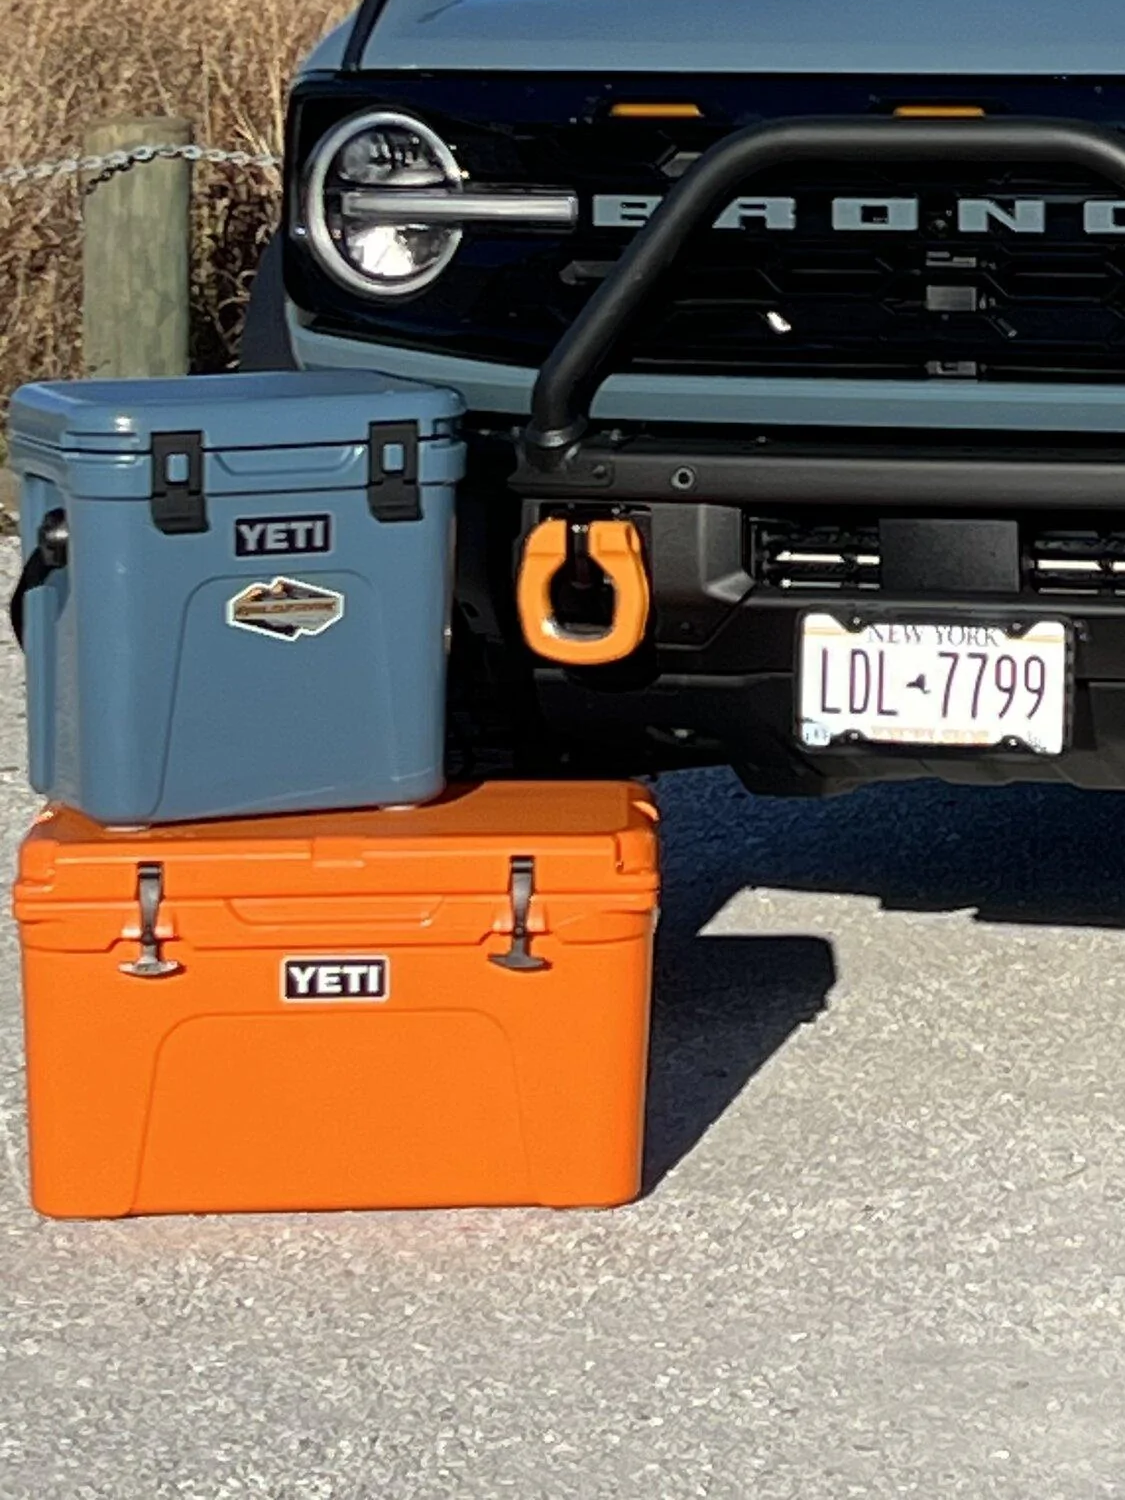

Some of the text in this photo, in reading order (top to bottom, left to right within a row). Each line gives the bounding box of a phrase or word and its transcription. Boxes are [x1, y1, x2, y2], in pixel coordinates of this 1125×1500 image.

[237, 520, 325, 551] YETI
[867, 624, 1000, 648] NEW YORK
[820, 647, 1046, 720] LDL 7799
[288, 964, 382, 994] YETI
